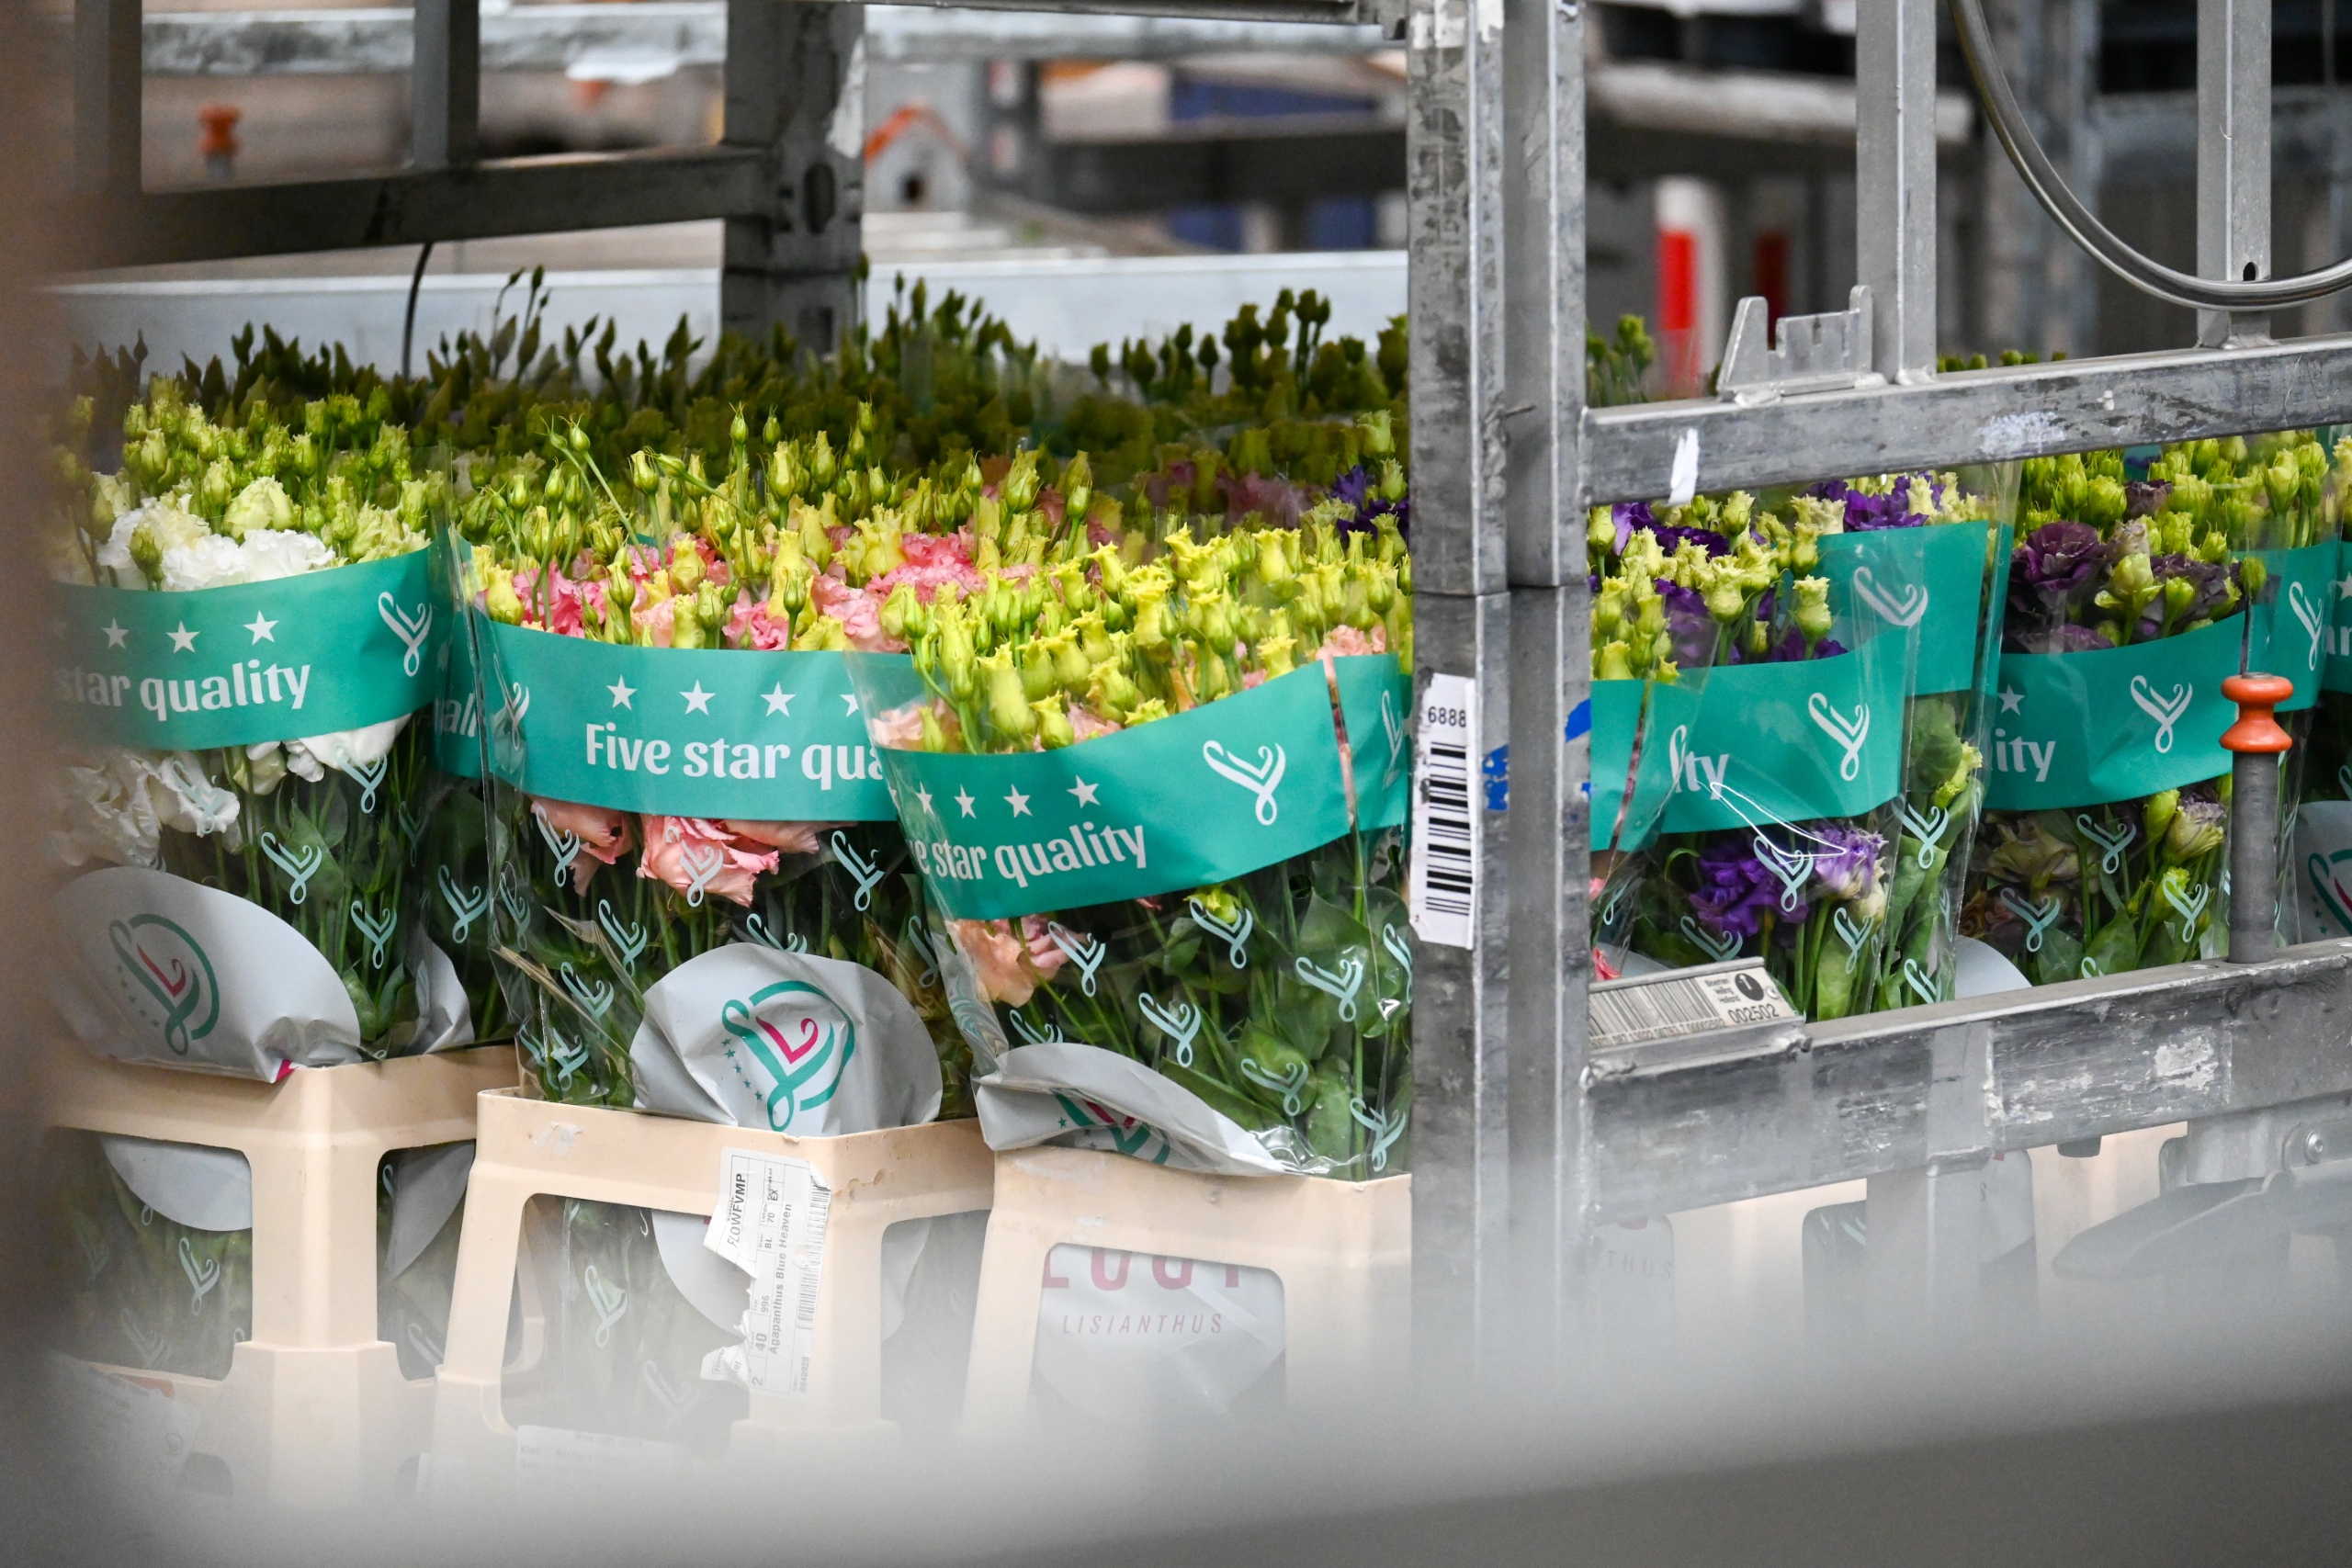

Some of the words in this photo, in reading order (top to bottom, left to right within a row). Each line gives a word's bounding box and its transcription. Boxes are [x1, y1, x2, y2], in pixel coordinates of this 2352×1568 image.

[140, 659, 311, 722] quality
[1428, 705, 1466, 728] 6888
[586, 721, 671, 775] Five
[683, 738, 790, 779] star
[932, 839, 987, 880] star
[994, 821, 1147, 888] quality
[1727, 1003, 1780, 1024] 002502
[726, 1173, 746, 1248] FLOWFVMP
[766, 1212, 775, 1224] 70
[778, 1203, 792, 1248] Heaven
[764, 1236, 773, 1249] BL
[775, 1253, 786, 1280] Blue
[761, 1295, 770, 1313] 996
[768, 1284, 784, 1355] Agapanthus
[1063, 1313, 1222, 1334] LISIANTHUS
[755, 1332, 767, 1351] 40
[751, 1376, 763, 1387] 2
